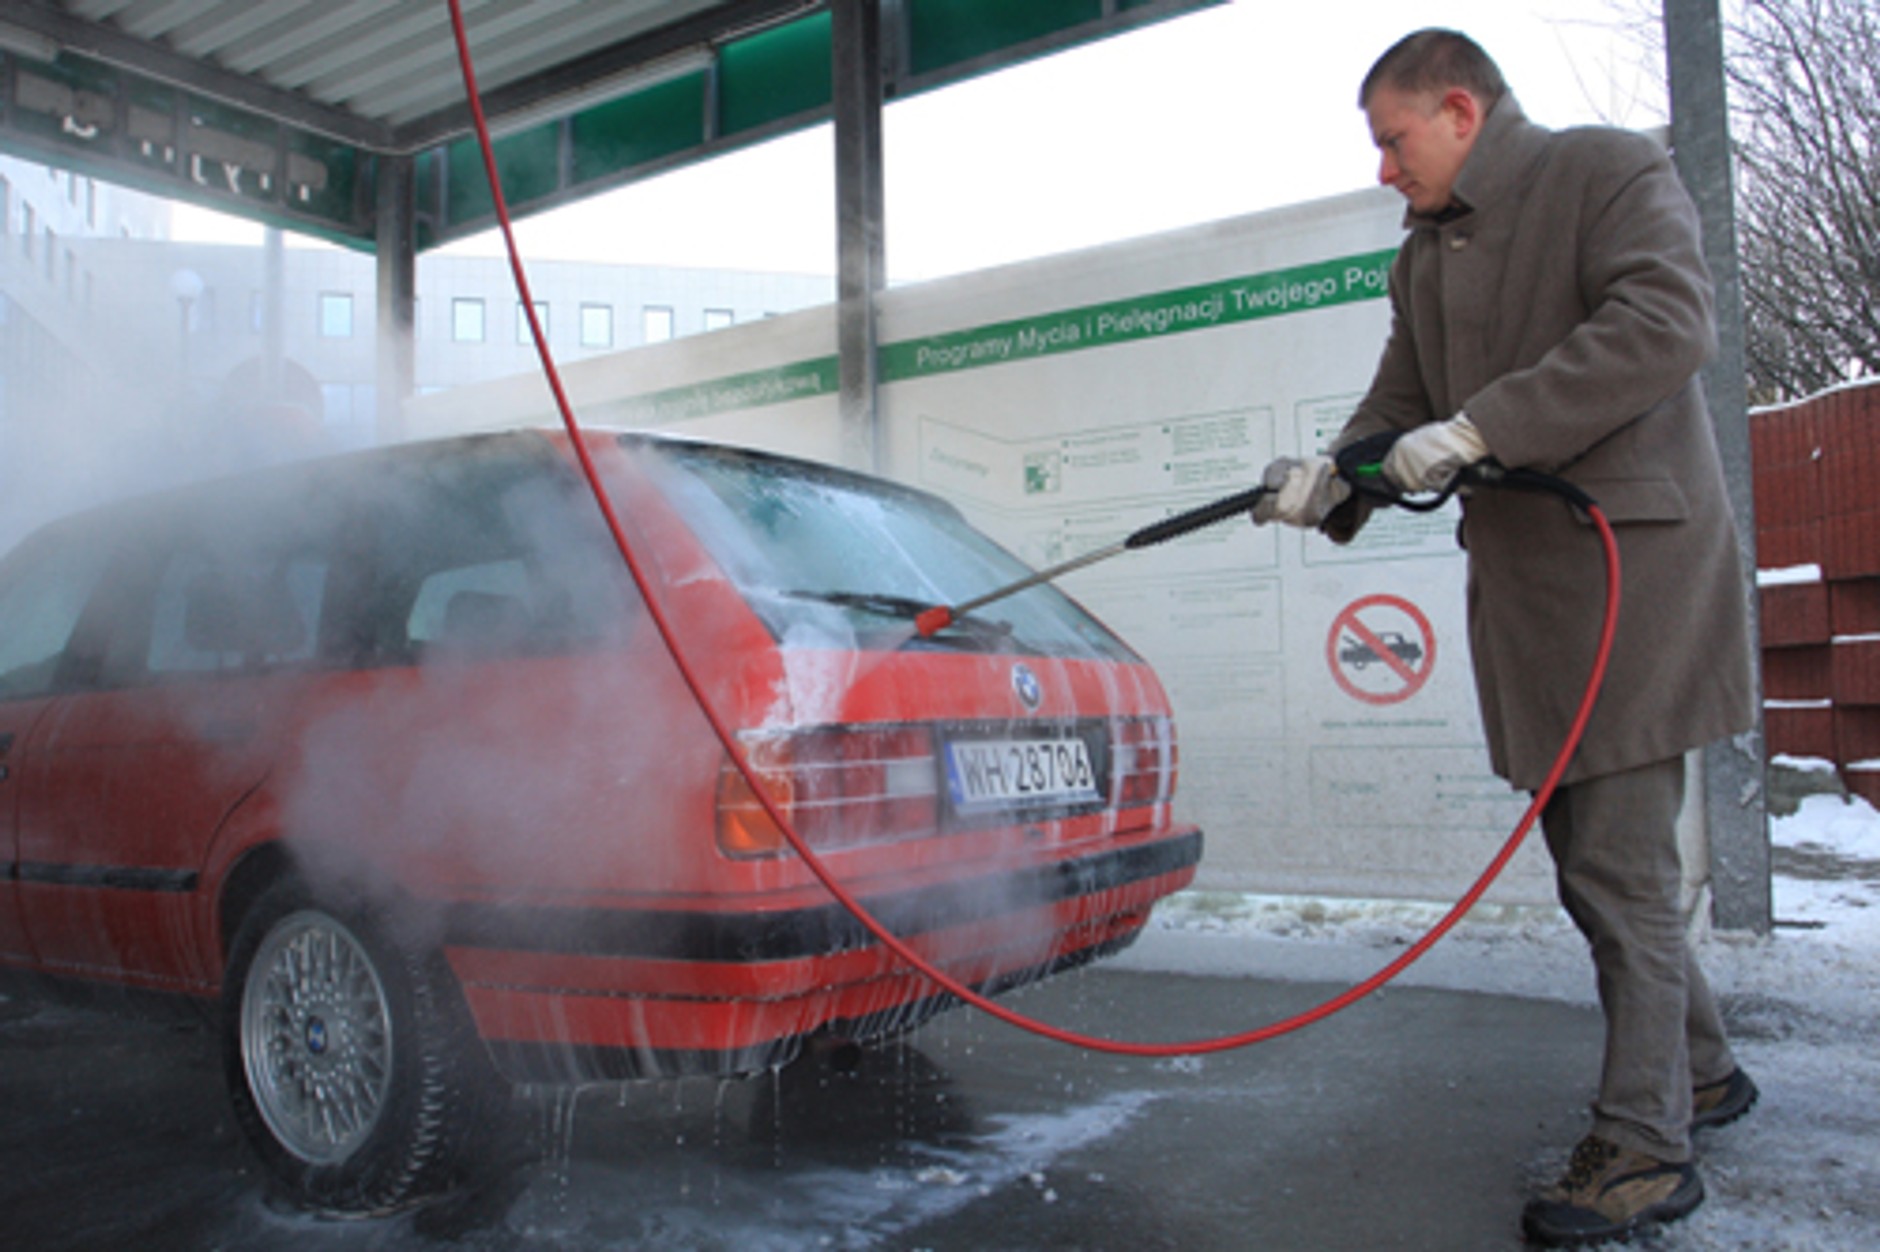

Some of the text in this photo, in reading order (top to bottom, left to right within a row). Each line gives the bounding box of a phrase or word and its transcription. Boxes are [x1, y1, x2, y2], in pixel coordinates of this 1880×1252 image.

[916, 335, 1013, 367] Programy
[1018, 322, 1081, 352] Mycia
[1086, 315, 1093, 337] i
[1097, 293, 1224, 336] Pielęgnacji
[1230, 278, 1337, 310] Twojego
[959, 743, 1089, 796] WH 28706
